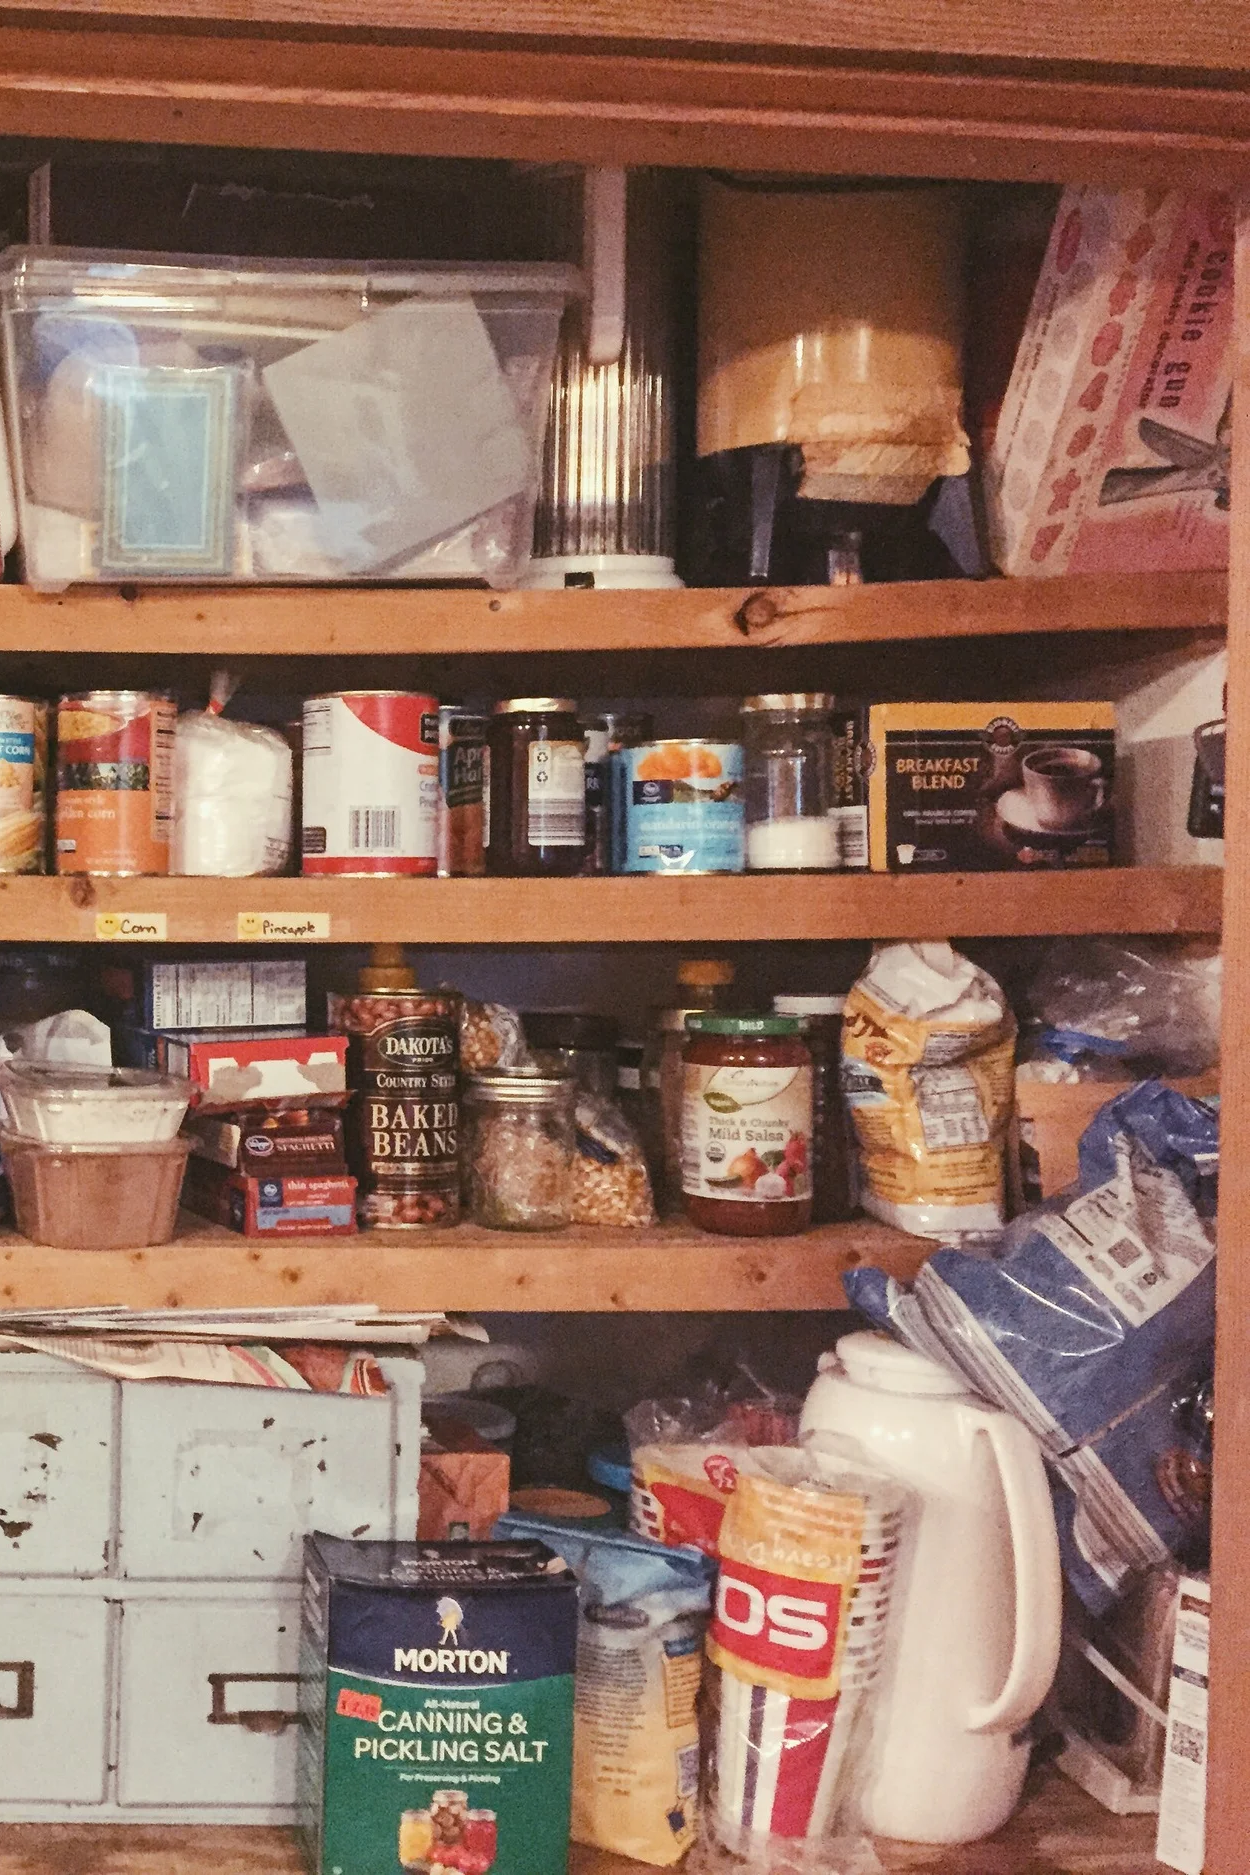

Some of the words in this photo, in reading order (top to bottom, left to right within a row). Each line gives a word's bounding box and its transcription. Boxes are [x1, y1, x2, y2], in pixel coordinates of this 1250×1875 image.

[5, 745, 31, 756] CORN
[895, 757, 979, 774] BREAKFAST
[911, 774, 966, 790] BLEND
[120, 919, 157, 935] Corn
[262, 920, 316, 937] Pineapple
[371, 1103, 459, 1130] BAKED
[709, 1116, 736, 1126] Thick
[750, 1118, 790, 1129] Chunky
[709, 1127, 741, 1141] Mild
[745, 1129, 784, 1142] Salsa
[276, 1141, 336, 1152] SPAGHETTI
[372, 1130, 458, 1158] BEANS
[394, 1648, 509, 1674] MORTON
[378, 1711, 503, 1734] CANNING
[508, 1713, 528, 1735] &
[354, 1737, 479, 1763] PICKLING
[484, 1740, 549, 1763] SALT
